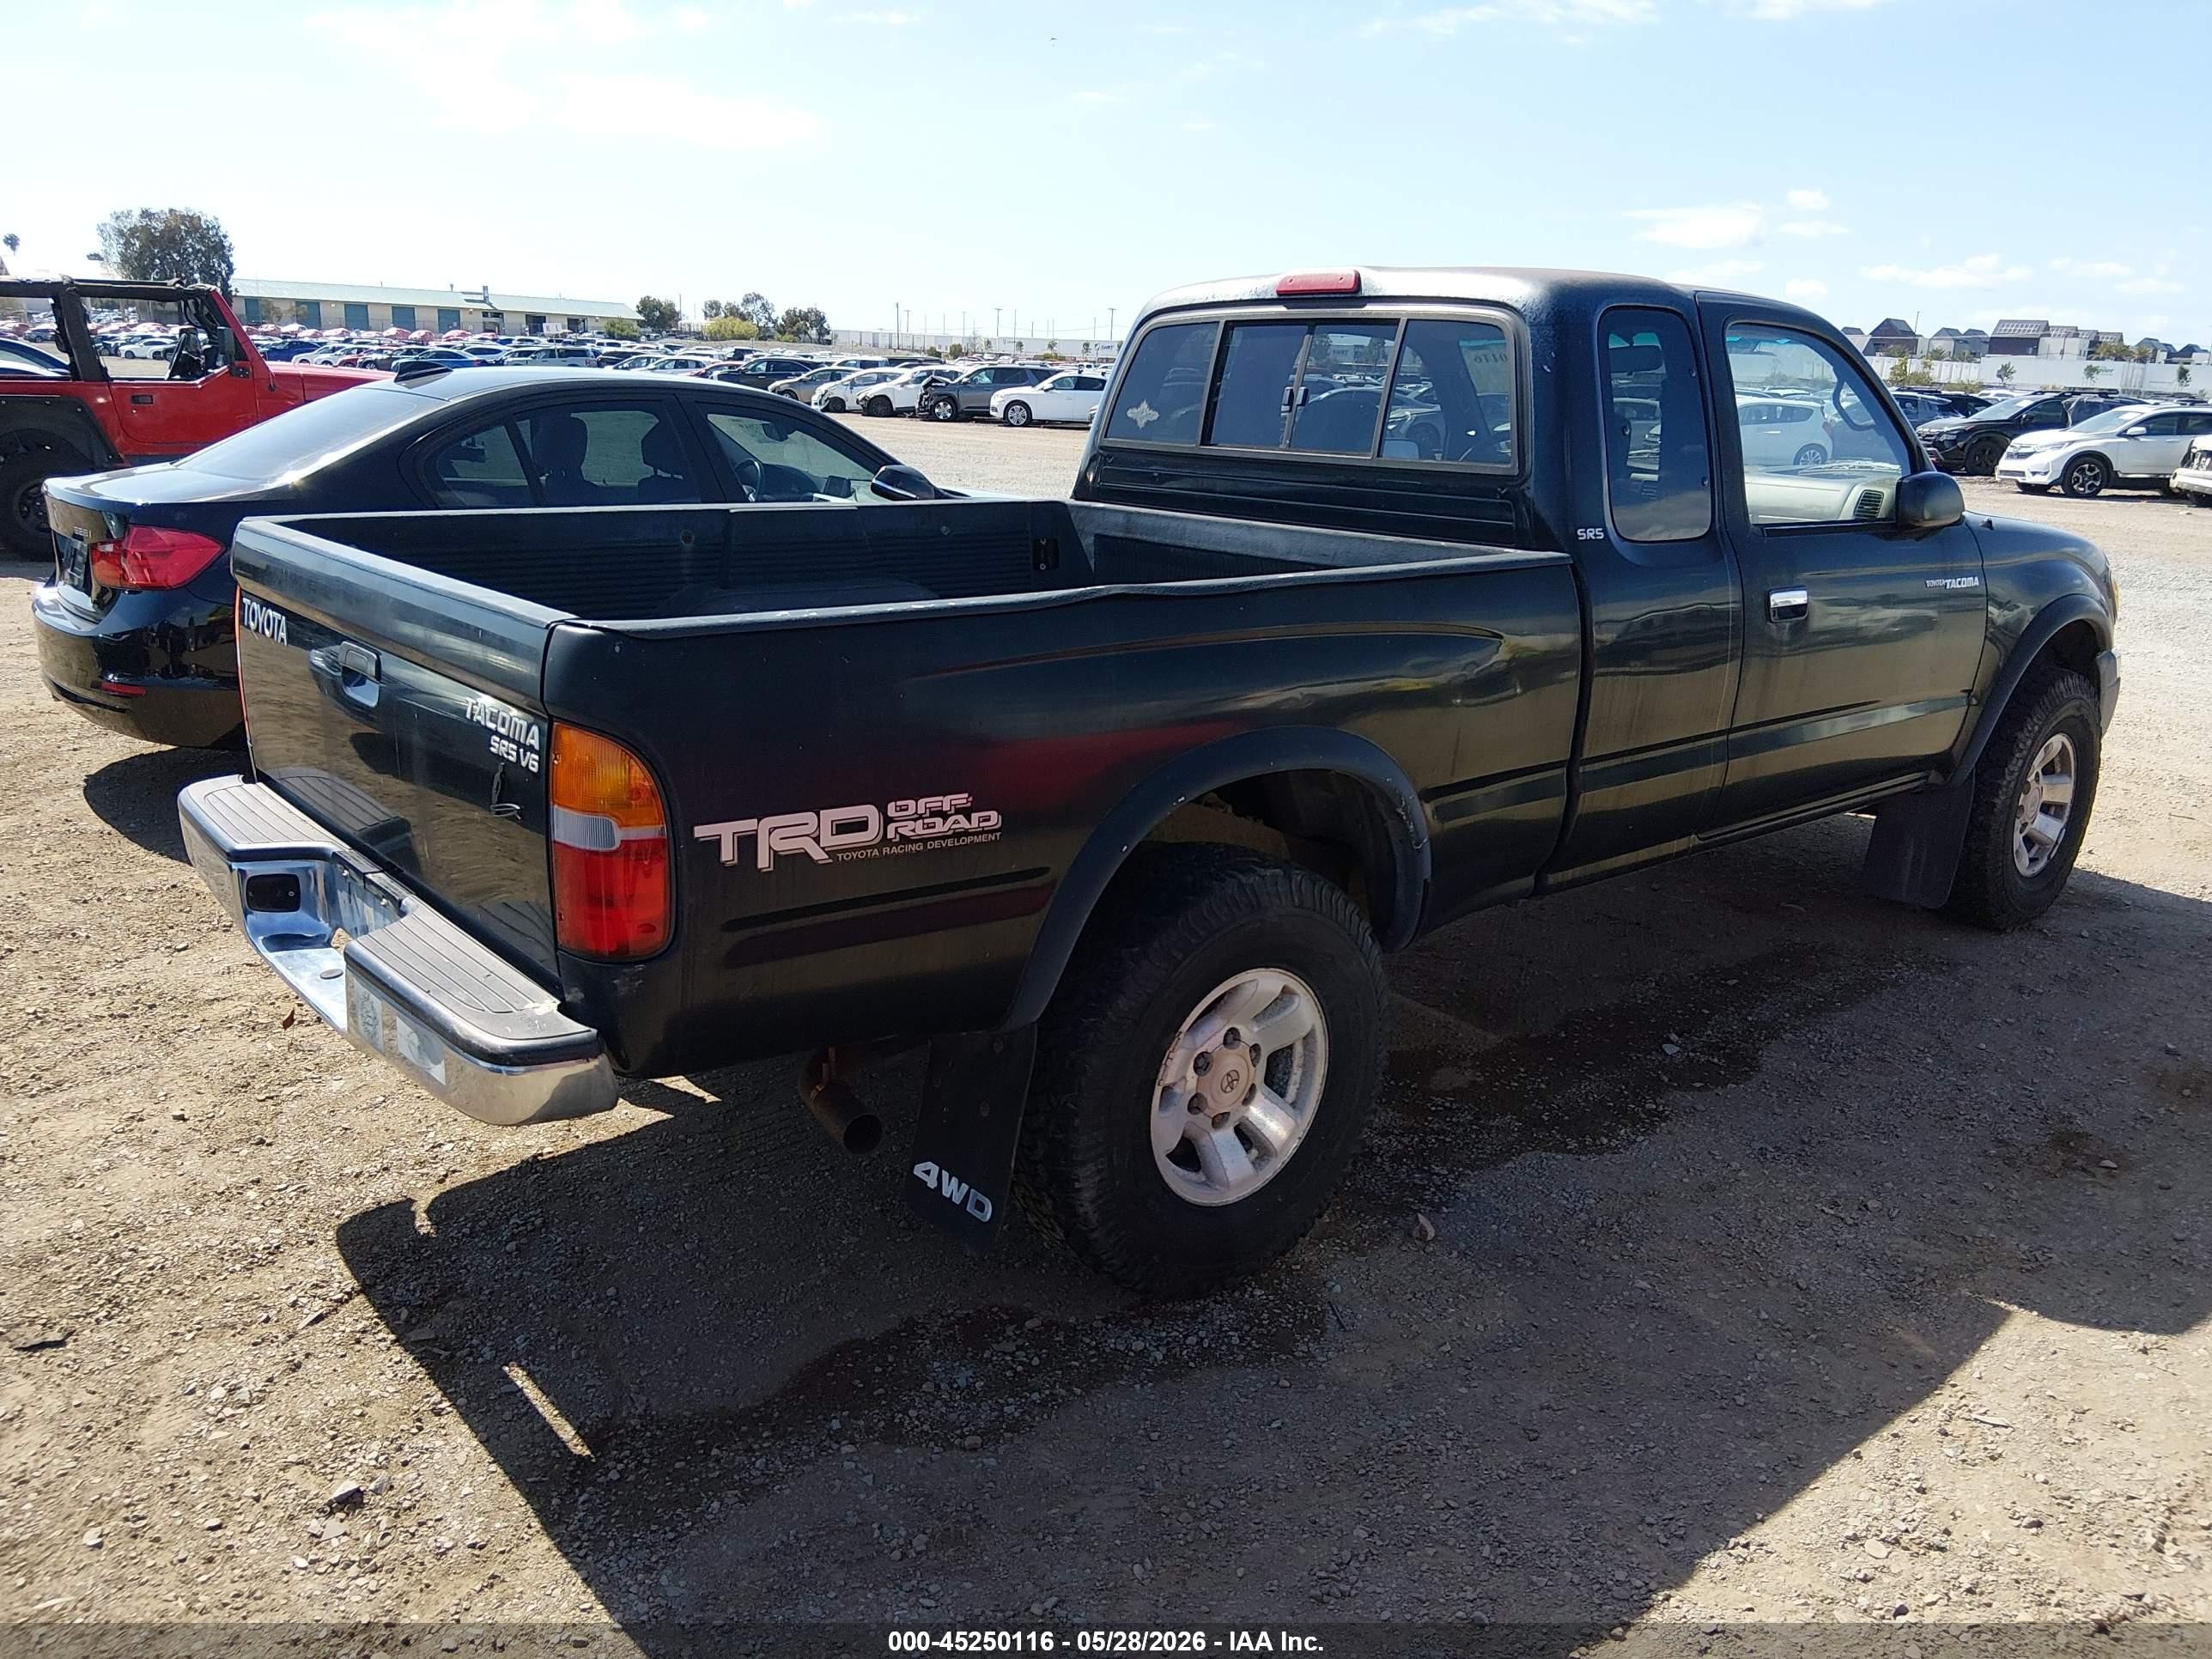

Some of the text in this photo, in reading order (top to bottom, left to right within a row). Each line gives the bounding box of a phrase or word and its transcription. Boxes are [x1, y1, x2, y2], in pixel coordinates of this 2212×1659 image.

[1577, 527, 1605, 540] SR5
[1945, 576, 1979, 590] TACOMA
[242, 598, 289, 647] TOYOTA
[465, 696, 540, 751] TACOMA
[489, 734, 539, 773] SR5 V6
[887, 793, 973, 818] OFF
[693, 804, 884, 872] TRD
[886, 810, 1002, 842] ROAD
[836, 832, 1001, 862] TOYOTA RACING DEVELOPMENT
[913, 1161, 993, 1223] 4WD
